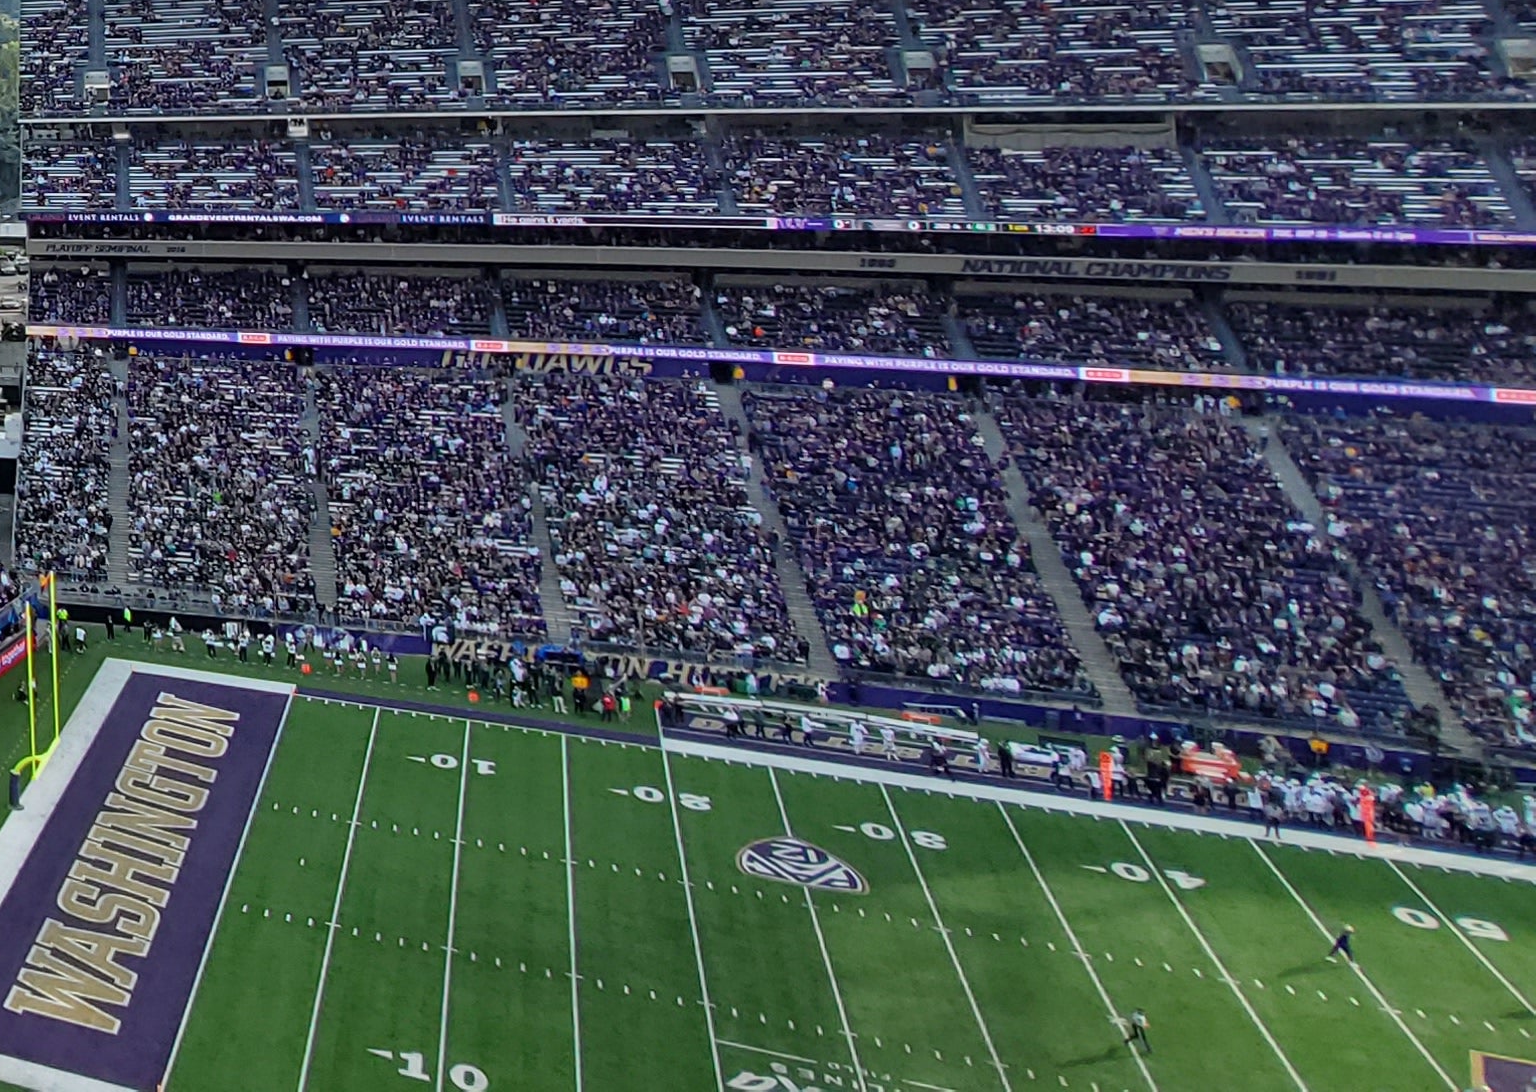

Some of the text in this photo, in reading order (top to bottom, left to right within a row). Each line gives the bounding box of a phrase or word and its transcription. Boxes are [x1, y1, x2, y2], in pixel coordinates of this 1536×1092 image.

[68, 213, 97, 221] EVENT
[100, 213, 139, 221] RENTALS
[403, 215, 435, 223] EVENT
[439, 215, 485, 223] RENTALS
[1035, 224, 1075, 234] 13:09
[46, 244, 151, 253] PLAYOFF SEMIFINAL
[961, 258, 1232, 281] NATIONAL CHAMPIONS
[108, 328, 136, 338] PURPLE
[145, 330, 162, 338] OUR
[163, 330, 185, 339] GOLD
[309, 336, 331, 344] WITH
[332, 336, 364, 345] PURPLE
[374, 337, 393, 346] OUR
[394, 338, 418, 347] GOLD
[609, 346, 644, 356] PURPLE
[656, 348, 677, 357] OUR
[679, 349, 705, 359] GOLD
[824, 356, 863, 366] PAYING
[865, 357, 894, 367] WITH
[896, 359, 936, 369] PURPLE
[950, 362, 975, 371] OUR
[977, 363, 1009, 373] GOLD
[1, 640, 25, 666] together
[430, 753, 496, 775] 10
[3, 691, 240, 1035] WASHINGTON
[1110, 860, 1207, 891] 40
[1391, 906, 1510, 943] 50
[397, 1051, 489, 1092] 10
